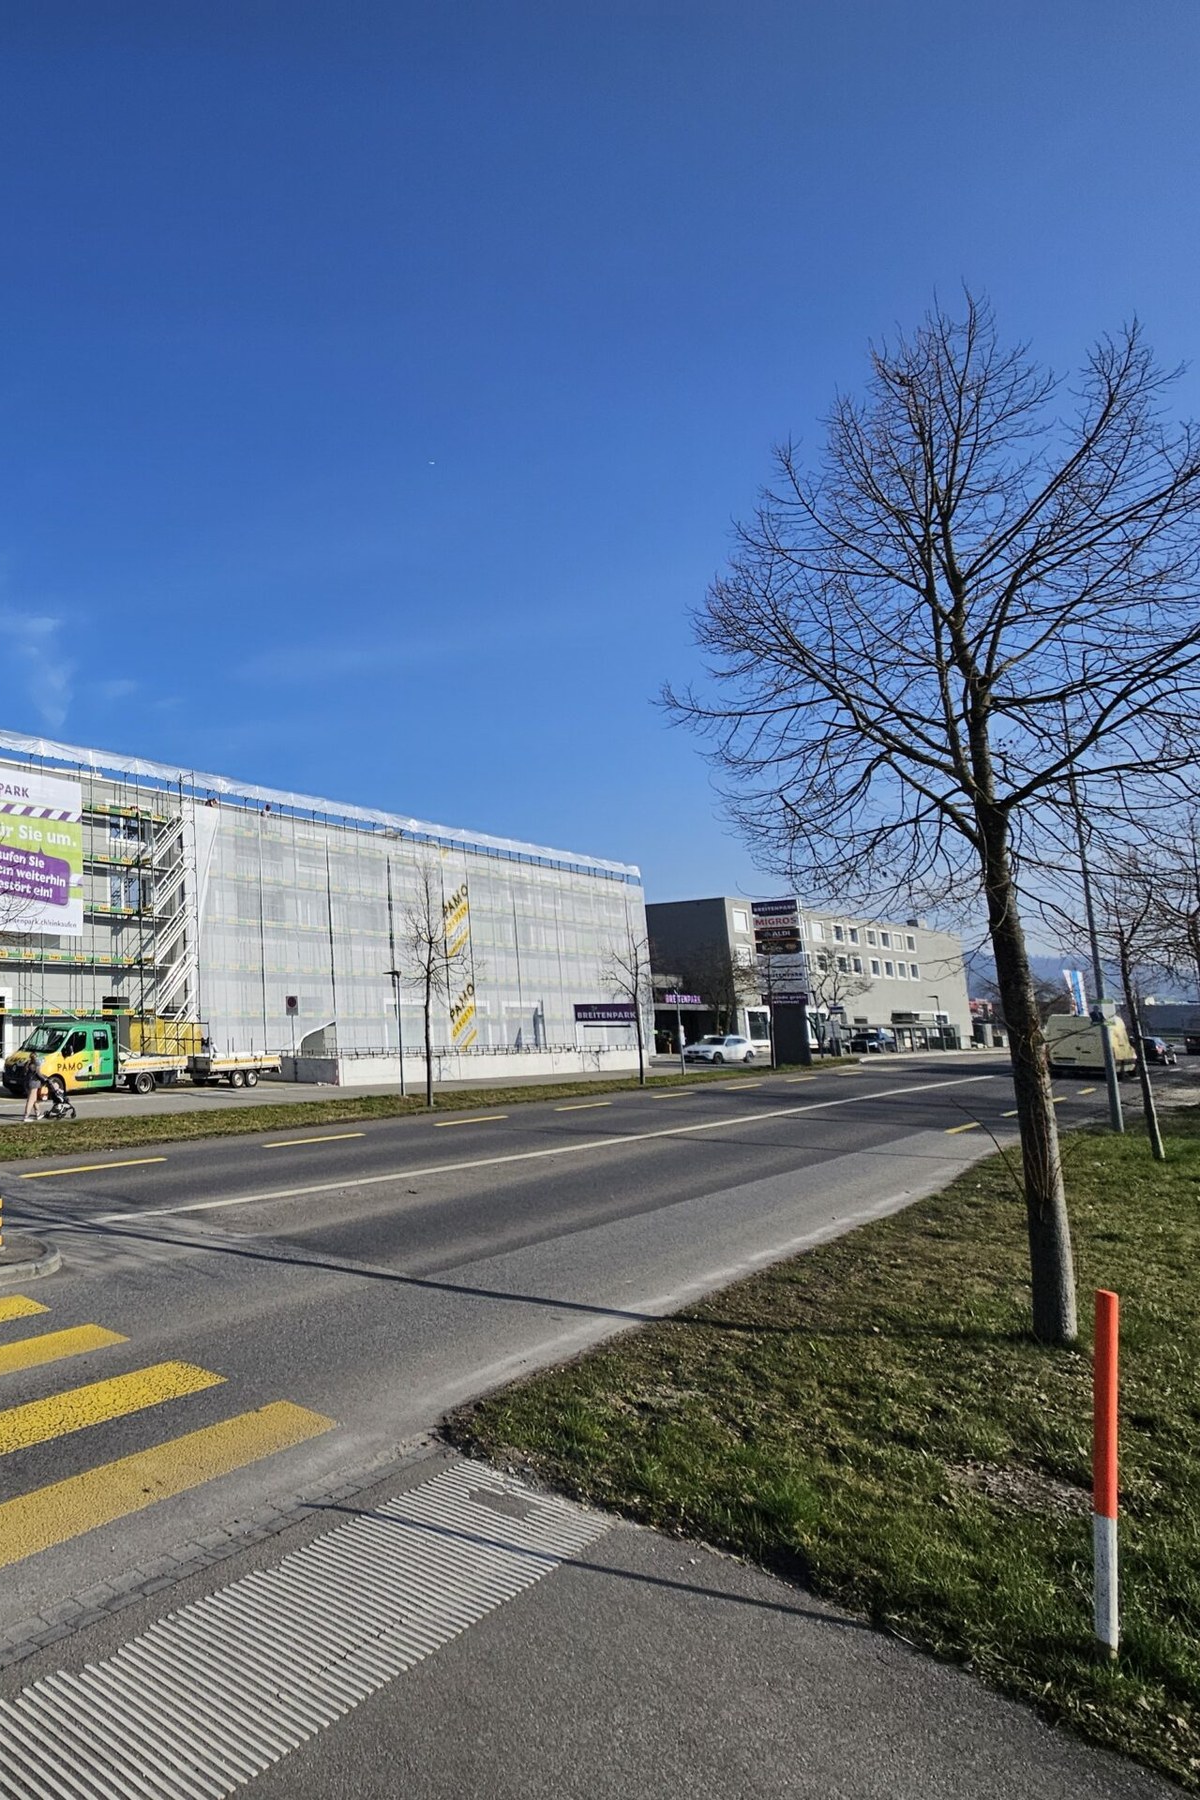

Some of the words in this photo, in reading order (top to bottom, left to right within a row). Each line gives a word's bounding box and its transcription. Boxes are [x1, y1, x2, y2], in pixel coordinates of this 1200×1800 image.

[18, 824, 43, 843] Sie
[46, 831, 77, 847] um.
[28, 856, 45, 868] Sie
[16, 868, 66, 887] weiterhin
[33, 886, 53, 898] ein!
[443, 884, 469, 919] PAMO
[755, 917, 796, 926] MIGROS
[450, 984, 475, 1024] PAMO
[577, 1011, 637, 1019] BREITENPARK
[56, 1061, 84, 1073] PAMO
